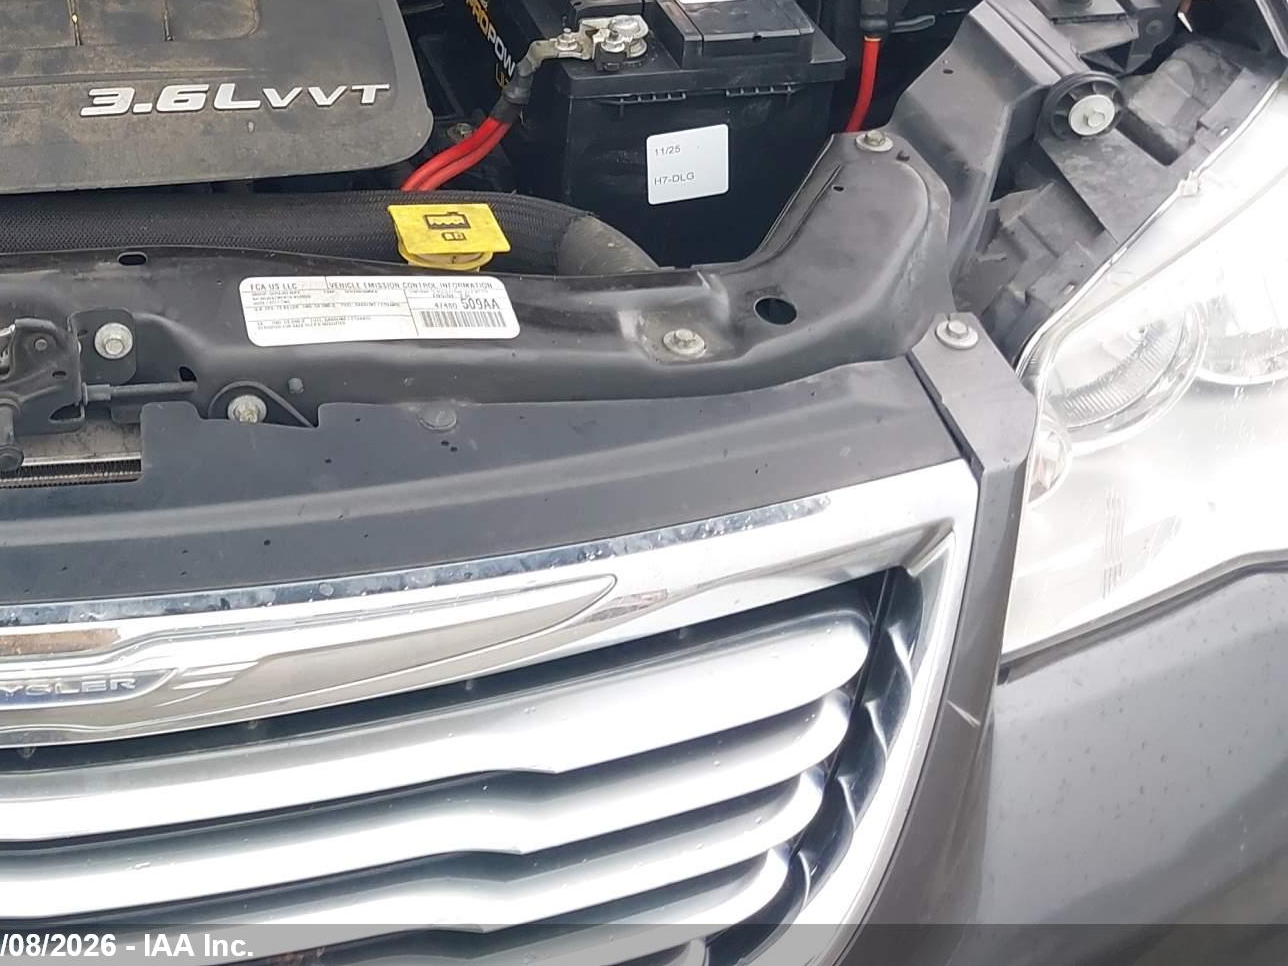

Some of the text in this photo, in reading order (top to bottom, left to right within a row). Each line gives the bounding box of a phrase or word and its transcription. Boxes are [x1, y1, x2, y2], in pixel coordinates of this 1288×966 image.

[655, 144, 681, 156] 11/25
[654, 172, 695, 186] H7-DLG
[363, 281, 400, 290] EMISSION
[402, 281, 436, 291] CONTROL
[438, 281, 493, 290] INFORMATION
[460, 297, 500, 310] 509AA
